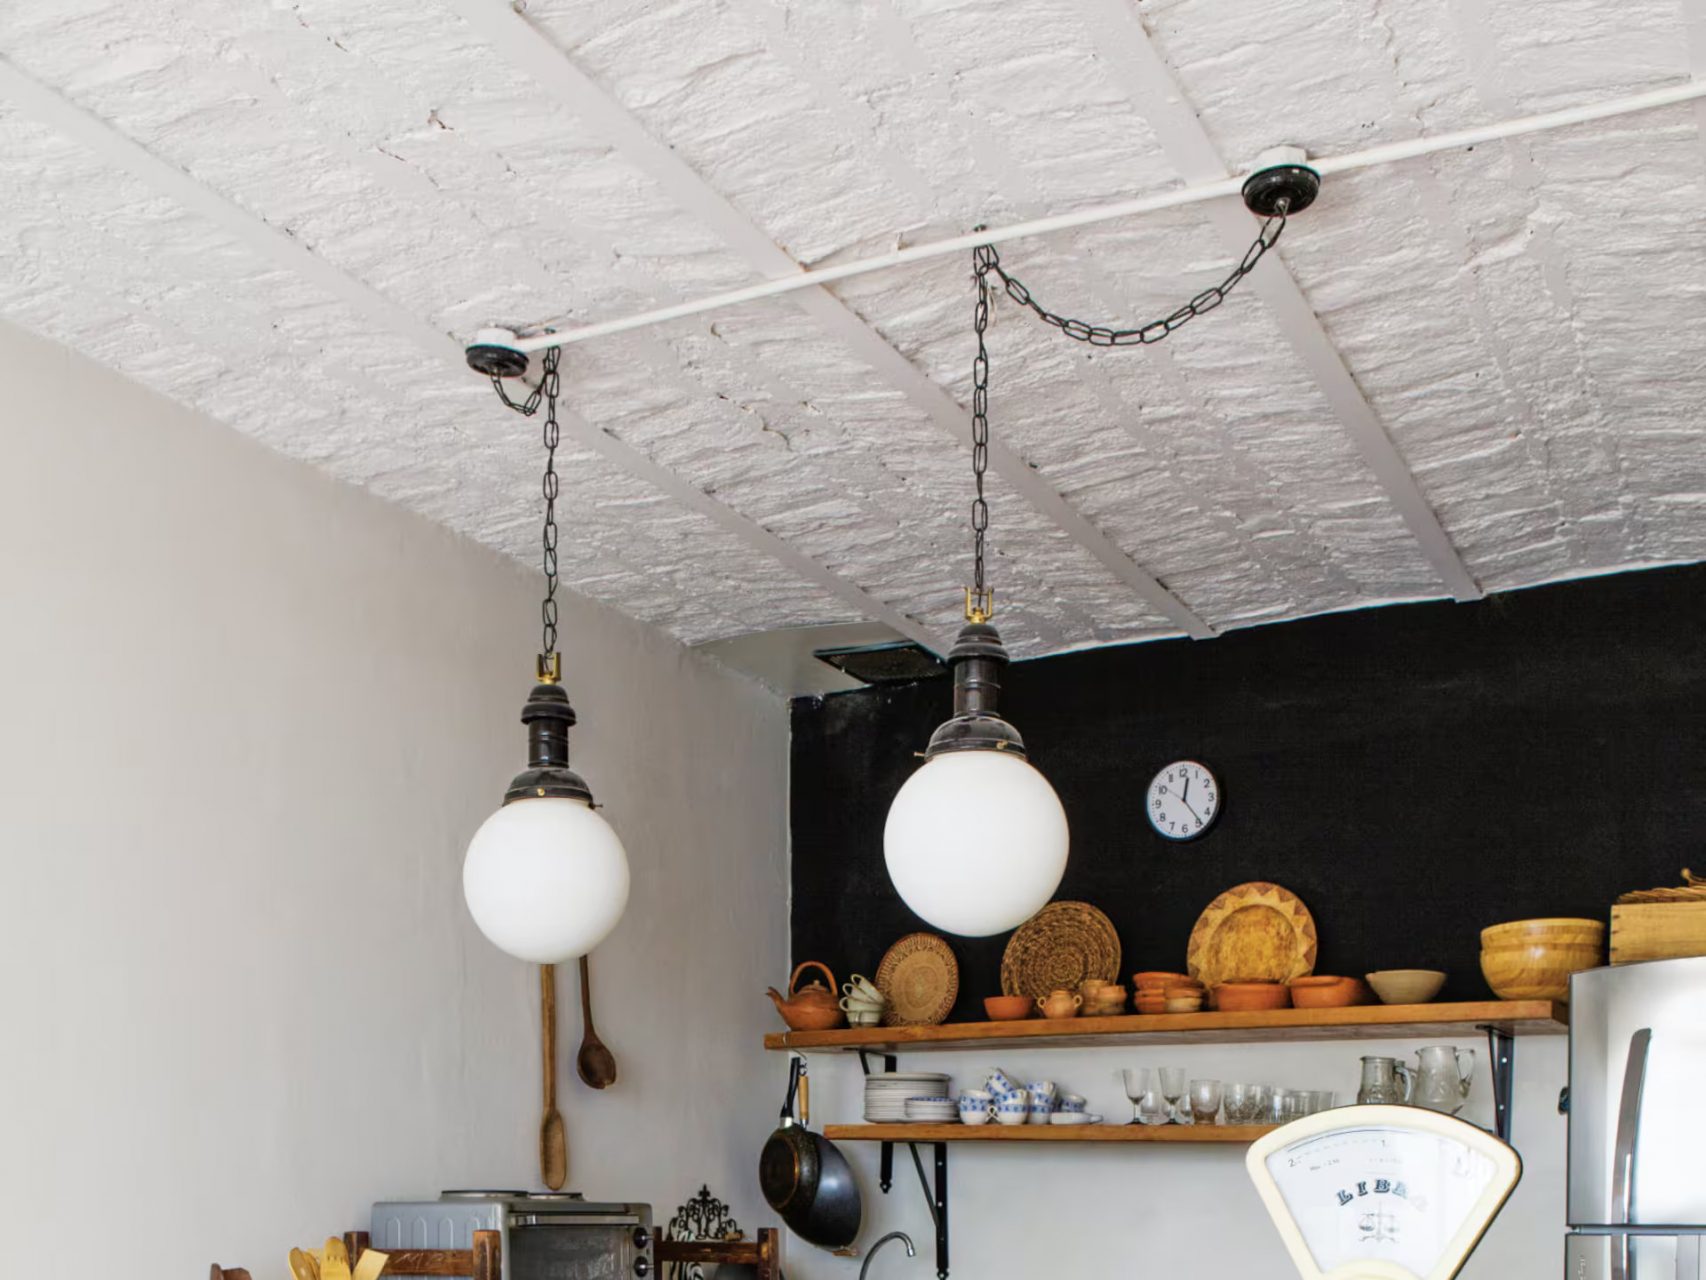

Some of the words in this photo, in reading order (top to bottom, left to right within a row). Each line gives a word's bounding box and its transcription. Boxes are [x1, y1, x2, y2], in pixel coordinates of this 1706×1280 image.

[1179, 767, 1188, 778] 12
[1195, 770, 1199, 778] 1
[1168, 774, 1174, 783] 11
[1204, 778, 1211, 788] 2
[1158, 785, 1168, 795] 10
[1208, 792, 1215, 802] 3
[1155, 799, 1162, 809] 9
[1204, 807, 1211, 816] 4
[1159, 812, 1166, 822] 8
[1169, 821, 1175, 831] 7
[1182, 824, 1188, 833] 6
[1336, 1179, 1427, 1211] LIBR
